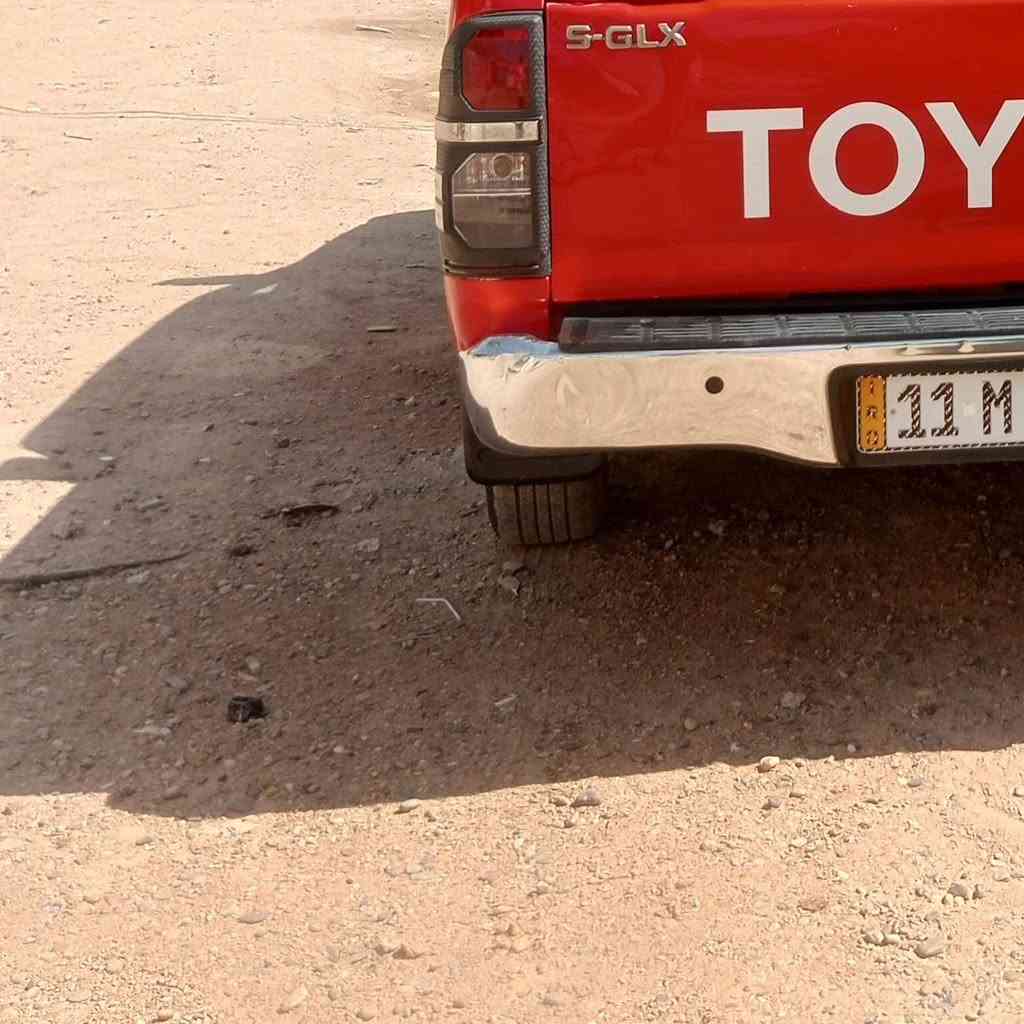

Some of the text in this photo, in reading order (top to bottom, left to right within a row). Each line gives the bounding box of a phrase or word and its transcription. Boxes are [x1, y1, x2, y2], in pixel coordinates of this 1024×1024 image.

[566, 22, 687, 50] S-GLX
[898, 382, 960, 438] 11
[983, 379, 1012, 435] M
